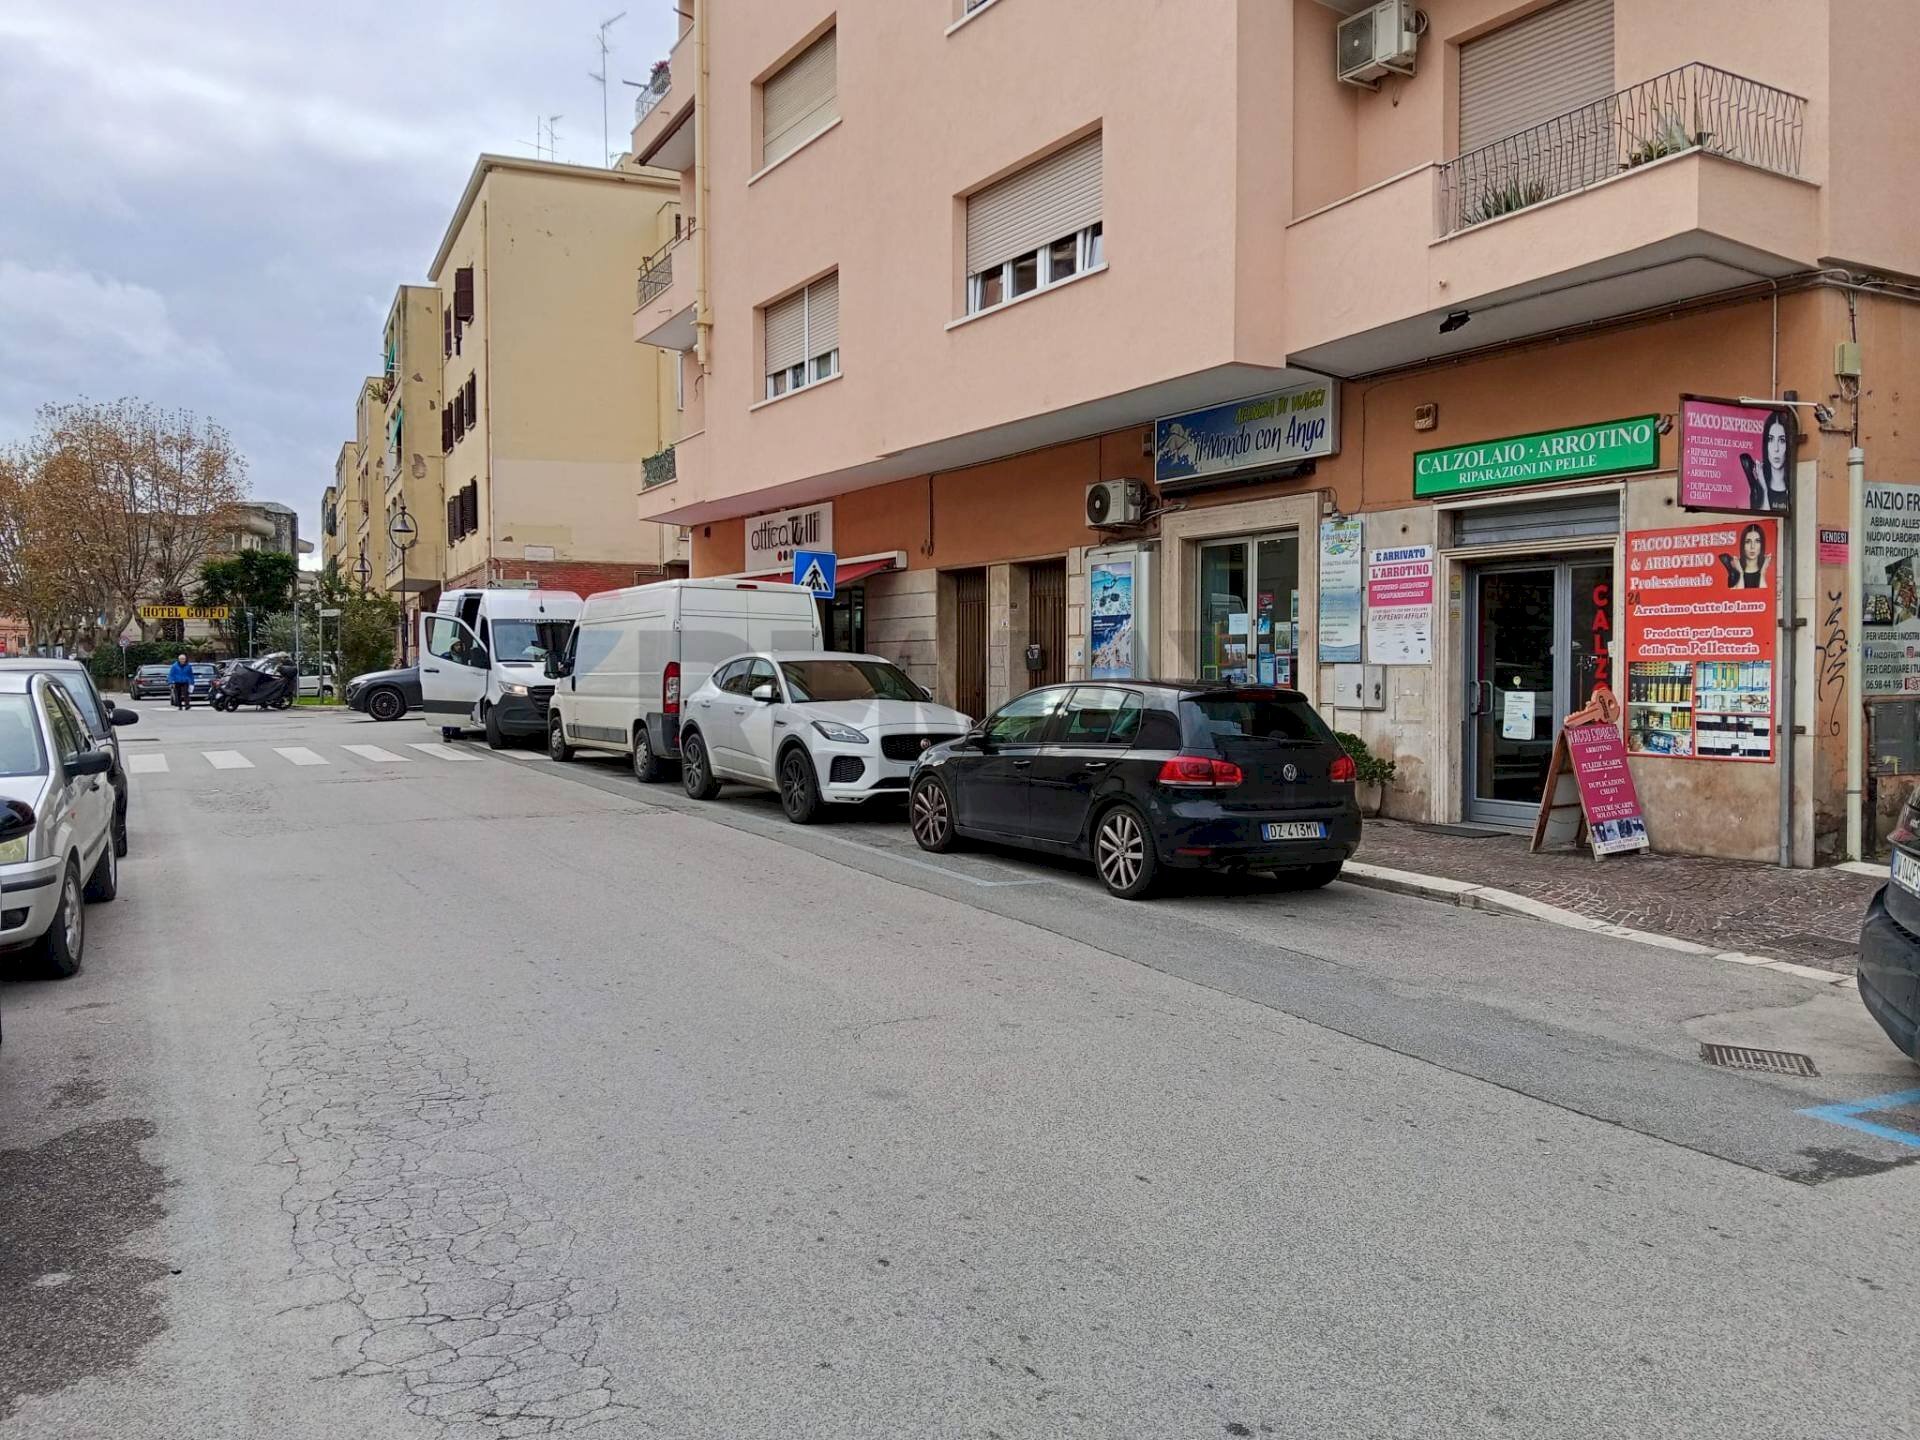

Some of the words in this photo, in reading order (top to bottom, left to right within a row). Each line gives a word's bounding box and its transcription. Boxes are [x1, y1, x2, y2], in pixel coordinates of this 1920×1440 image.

[1687, 412, 1720, 429] TACCO
[1721, 416, 1764, 433] EXPRESS
[1255, 426, 1281, 452] con
[1286, 415, 1325, 452] Anya
[1418, 443, 1525, 475] CALZOLAIO
[1536, 424, 1650, 458] ARROTINO
[1459, 464, 1536, 484] RIPARAZIONI
[1539, 460, 1552, 473] IN
[1555, 454, 1598, 472] PELLE
[1865, 490, 1903, 511] ANZIO
[1870, 516, 1901, 529] ABBIAMO
[1631, 535, 1672, 552] TACCO
[1673, 530, 1737, 549] EXPRESS
[1822, 531, 1847, 543] VENDESI
[1867, 531, 1891, 542] NUOVO
[1892, 533, 1920, 544] LABORAT
[1382, 548, 1425, 561] ARRIVATO
[1864, 546, 1887, 556] PIATTI
[1888, 547, 1909, 558] PRONTI
[1630, 557, 1641, 571] &
[1644, 552, 1715, 570] ARROTINO
[1372, 564, 1429, 579] L'ARROTINO
[1630, 573, 1713, 590] Professionale
[143, 607, 181, 618] HOTEL
[187, 607, 224, 618] GOLFO
[1635, 604, 1691, 616] Arrotiamo
[1692, 602, 1721, 614] tutte
[1724, 601, 1734, 612] le
[1735, 600, 1765, 612] lame
[1645, 627, 1689, 639] Prodotti
[1691, 628, 1712, 640] per
[1713, 627, 1725, 637] la
[1726, 627, 1752, 637] cura
[1866, 632, 1876, 641] PER
[1640, 644, 1666, 656] della
[1667, 644, 1689, 655] Tua
[1689, 641, 1759, 655] Pelletteria
[1269, 824, 1285, 838] DZ
[1287, 823, 1319, 837] 413MV
